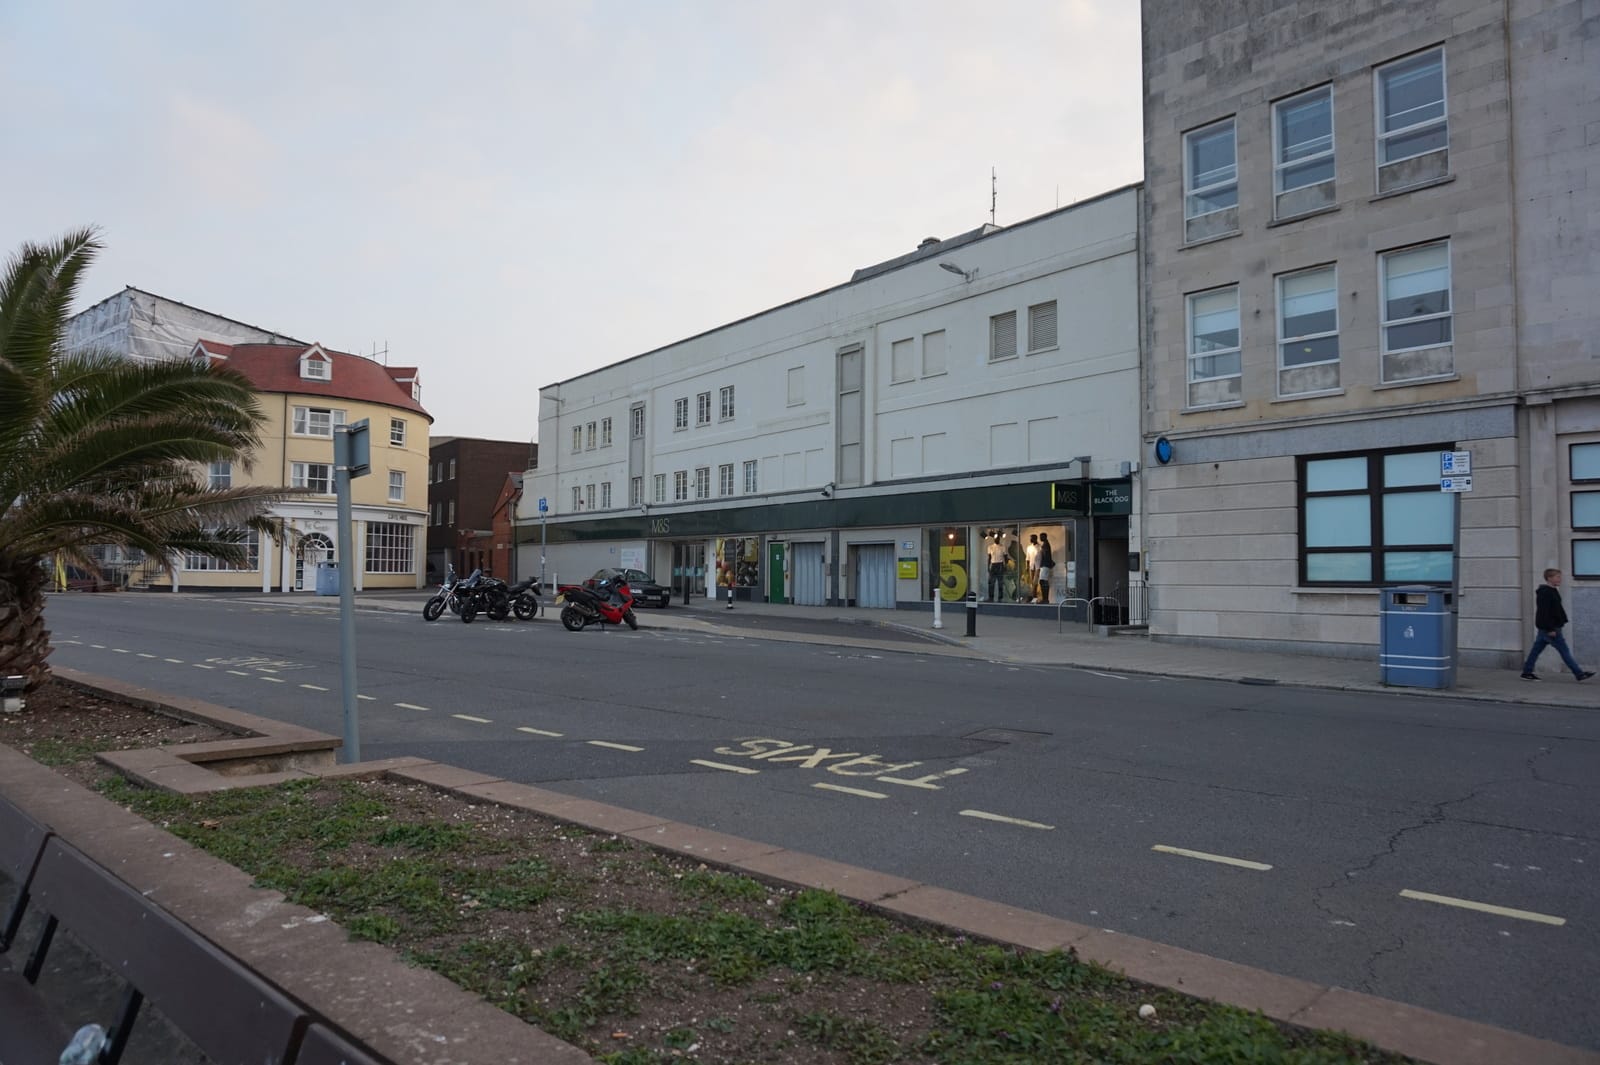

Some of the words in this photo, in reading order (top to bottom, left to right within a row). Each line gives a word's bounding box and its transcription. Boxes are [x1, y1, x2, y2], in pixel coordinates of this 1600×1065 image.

[1057, 490, 1077, 503] M&S
[652, 518, 670, 534] M&S
[940, 546, 968, 601] 5
[713, 737, 969, 789] TAXIS
